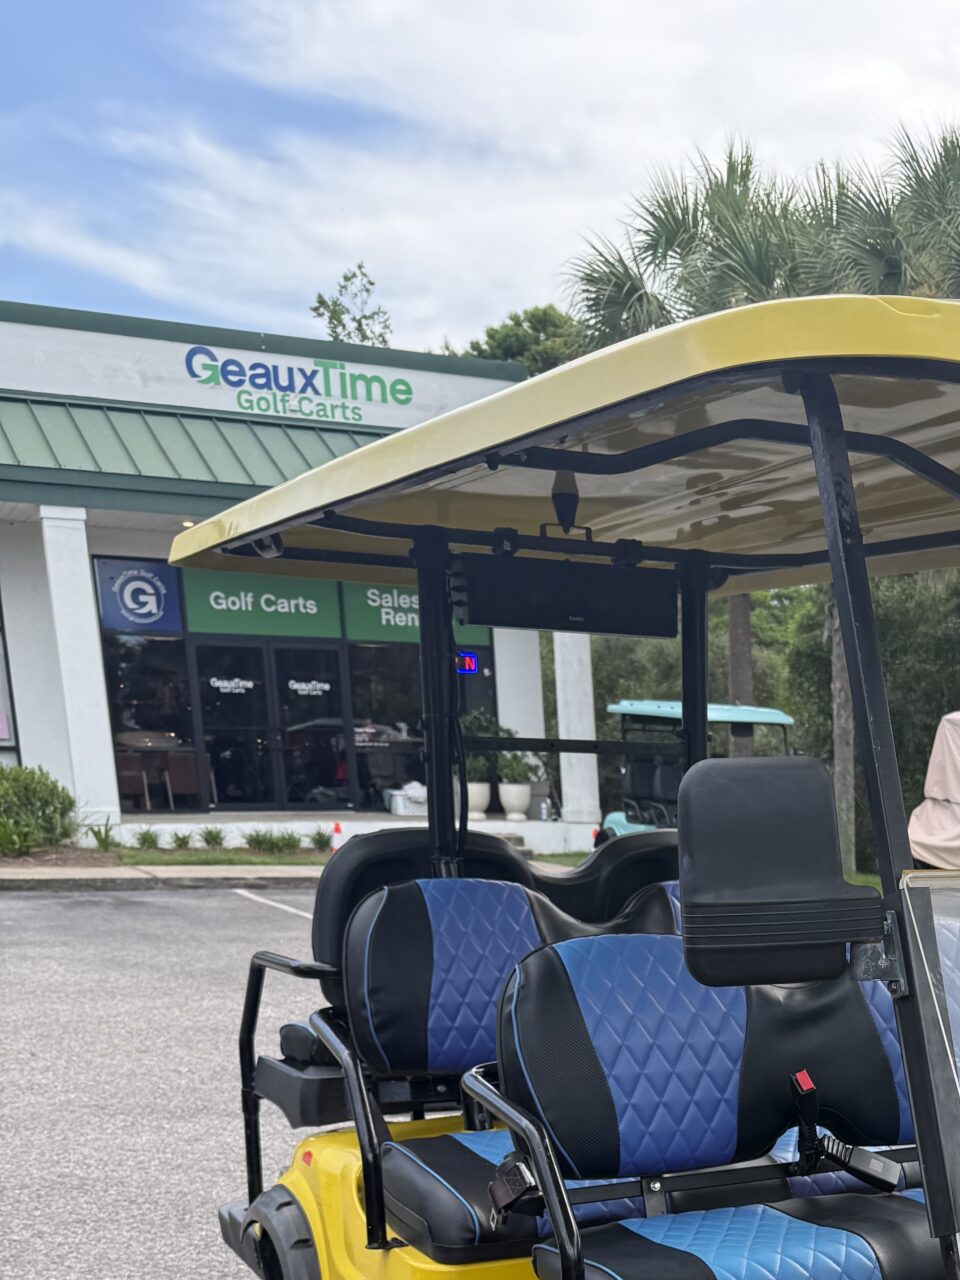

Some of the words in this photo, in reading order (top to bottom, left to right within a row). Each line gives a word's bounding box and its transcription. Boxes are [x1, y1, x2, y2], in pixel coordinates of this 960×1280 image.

[185, 346, 413, 405] GeauxTime
[236, 389, 290, 414] Golf
[299, 396, 362, 421] Carts
[209, 591, 253, 611] Golf
[260, 593, 318, 614] Carts
[366, 589, 419, 608] Sales
